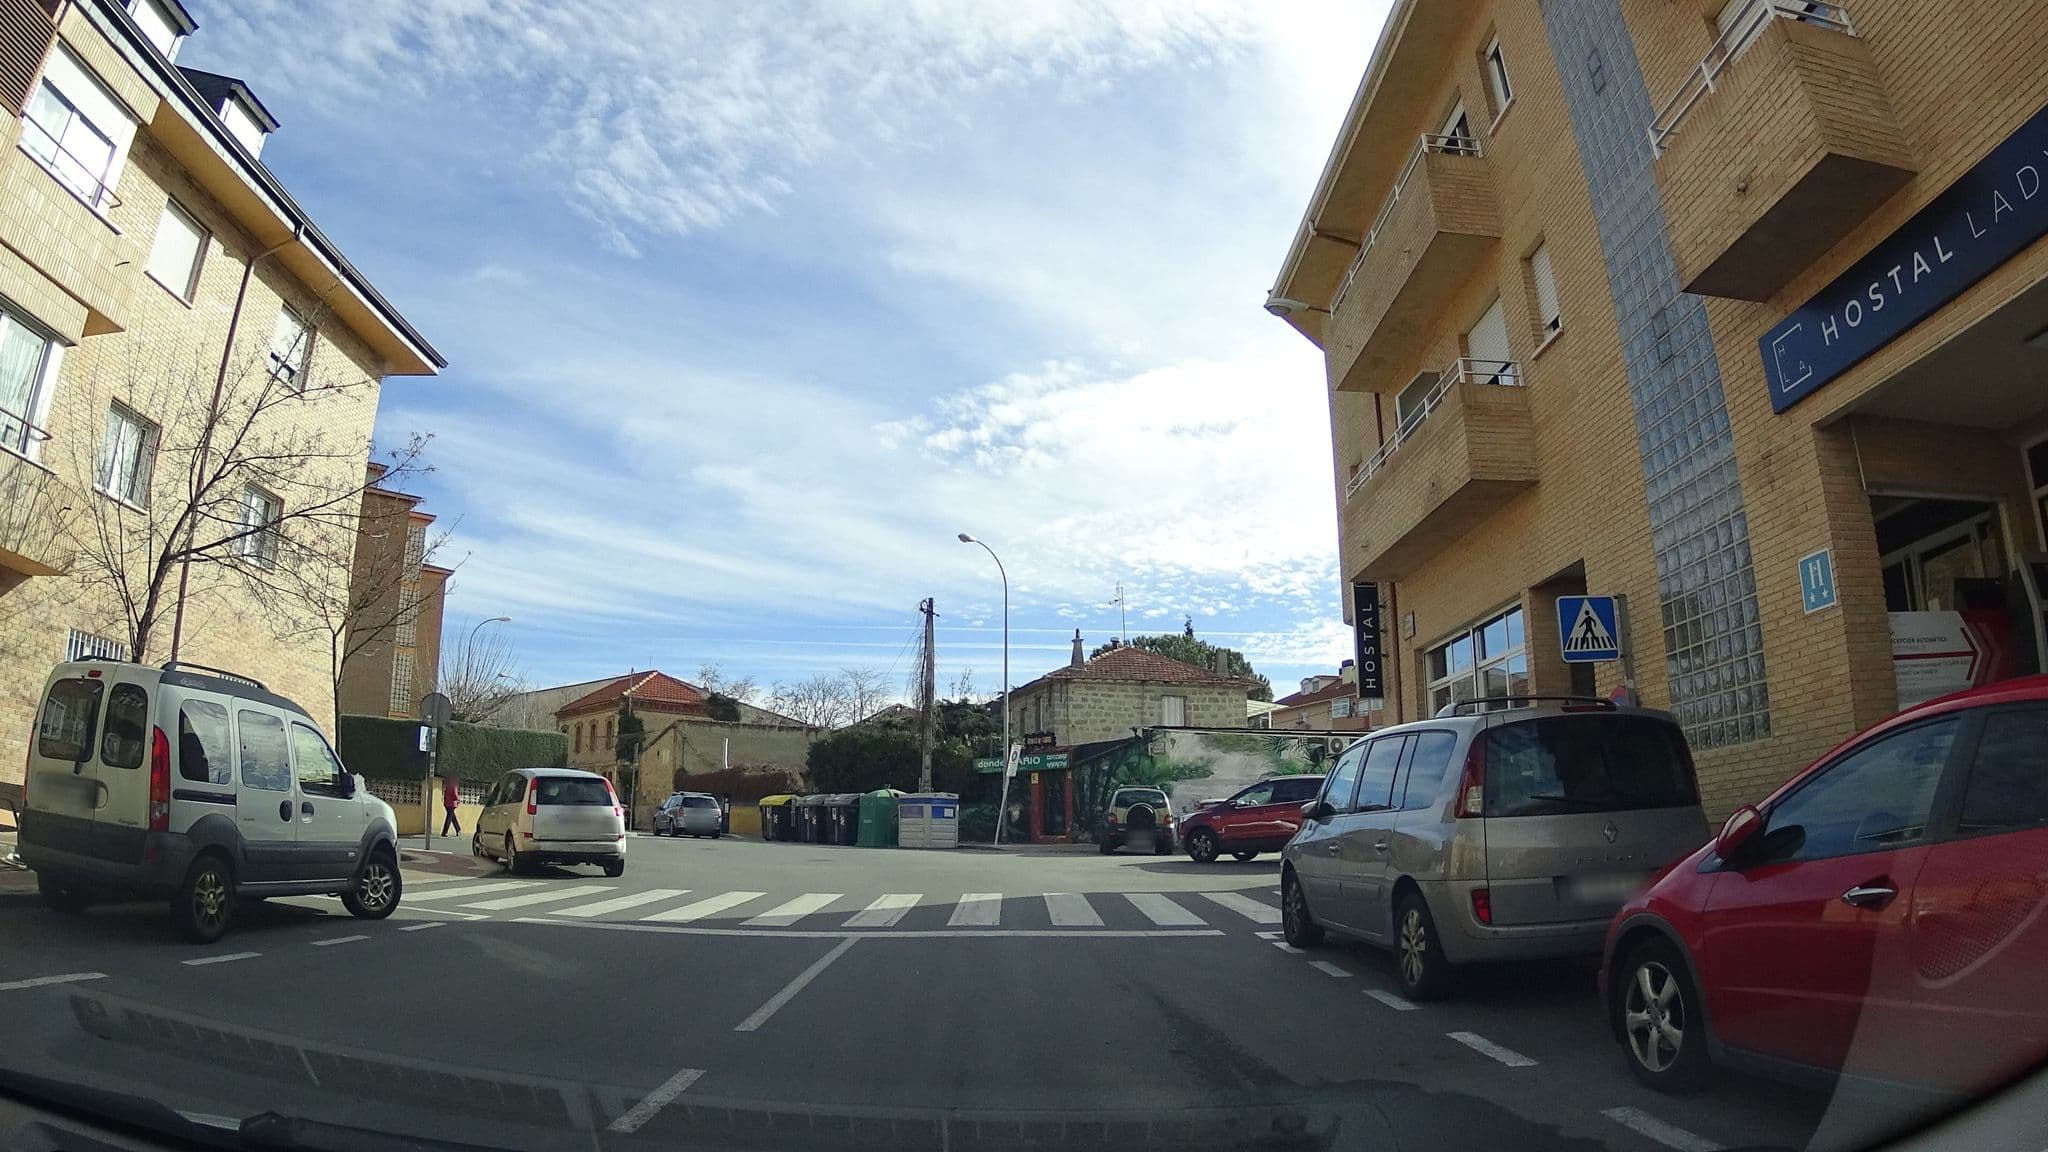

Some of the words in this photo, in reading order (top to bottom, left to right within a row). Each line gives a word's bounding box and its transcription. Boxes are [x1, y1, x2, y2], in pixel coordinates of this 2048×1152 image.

[1821, 236, 1953, 346] HOSTAL
[1966, 150, 2048, 239] LAD
[1362, 603, 1376, 689] HOSTAL
[1017, 756, 1041, 765] ARIO
